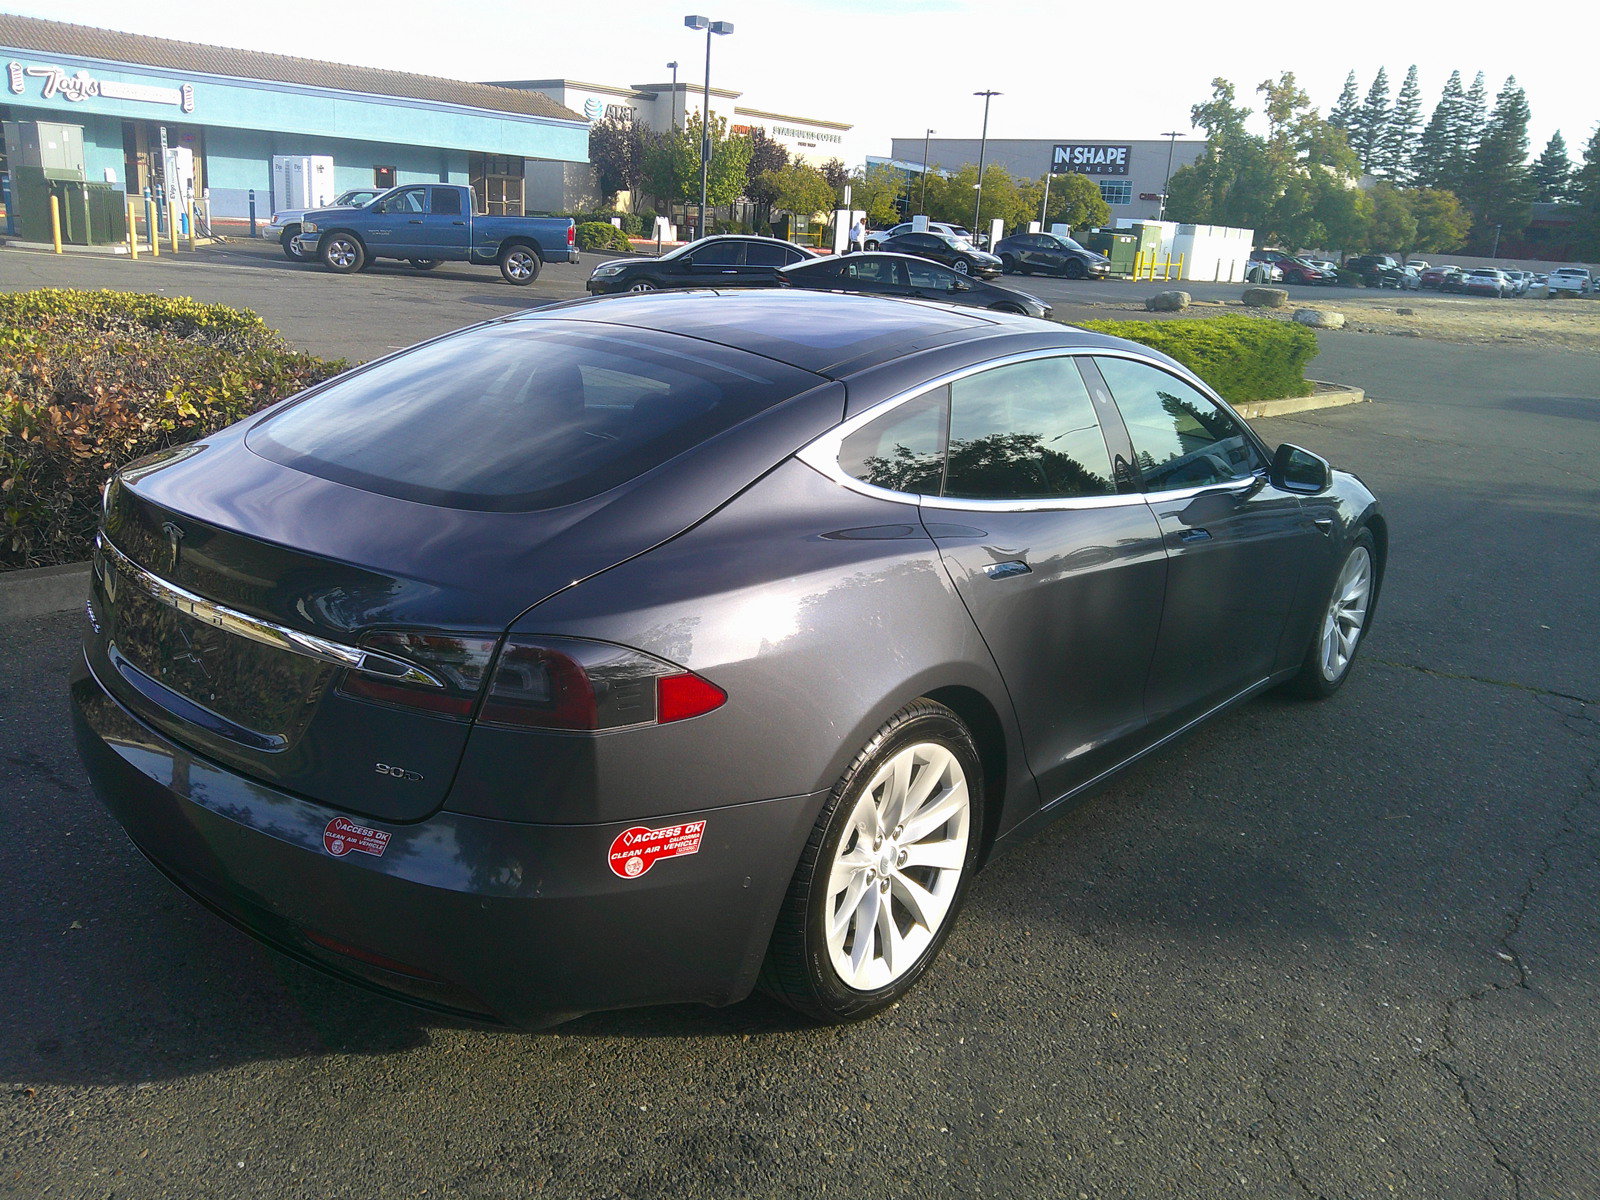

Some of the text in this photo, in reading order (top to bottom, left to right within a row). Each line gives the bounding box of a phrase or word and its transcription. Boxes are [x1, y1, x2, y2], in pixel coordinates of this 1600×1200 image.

[604, 104, 638, 121] AT&T
[816, 132, 842, 144] COFFEE
[1054, 147, 1127, 164] IN-SHAPE
[1053, 165, 1125, 173] FITNESS
[375, 763, 424, 781] 90D
[325, 831, 346, 840] CLEAN
[359, 839, 385, 850] VEHICLE
[341, 823, 389, 841] ACCESS OK
[632, 823, 703, 844] ACCESS OK
[669, 833, 700, 843] CALIFORNIA
[611, 849, 642, 860] CLEAN
[644, 845, 661, 854] AIR
[663, 838, 699, 851] VEHICLE
